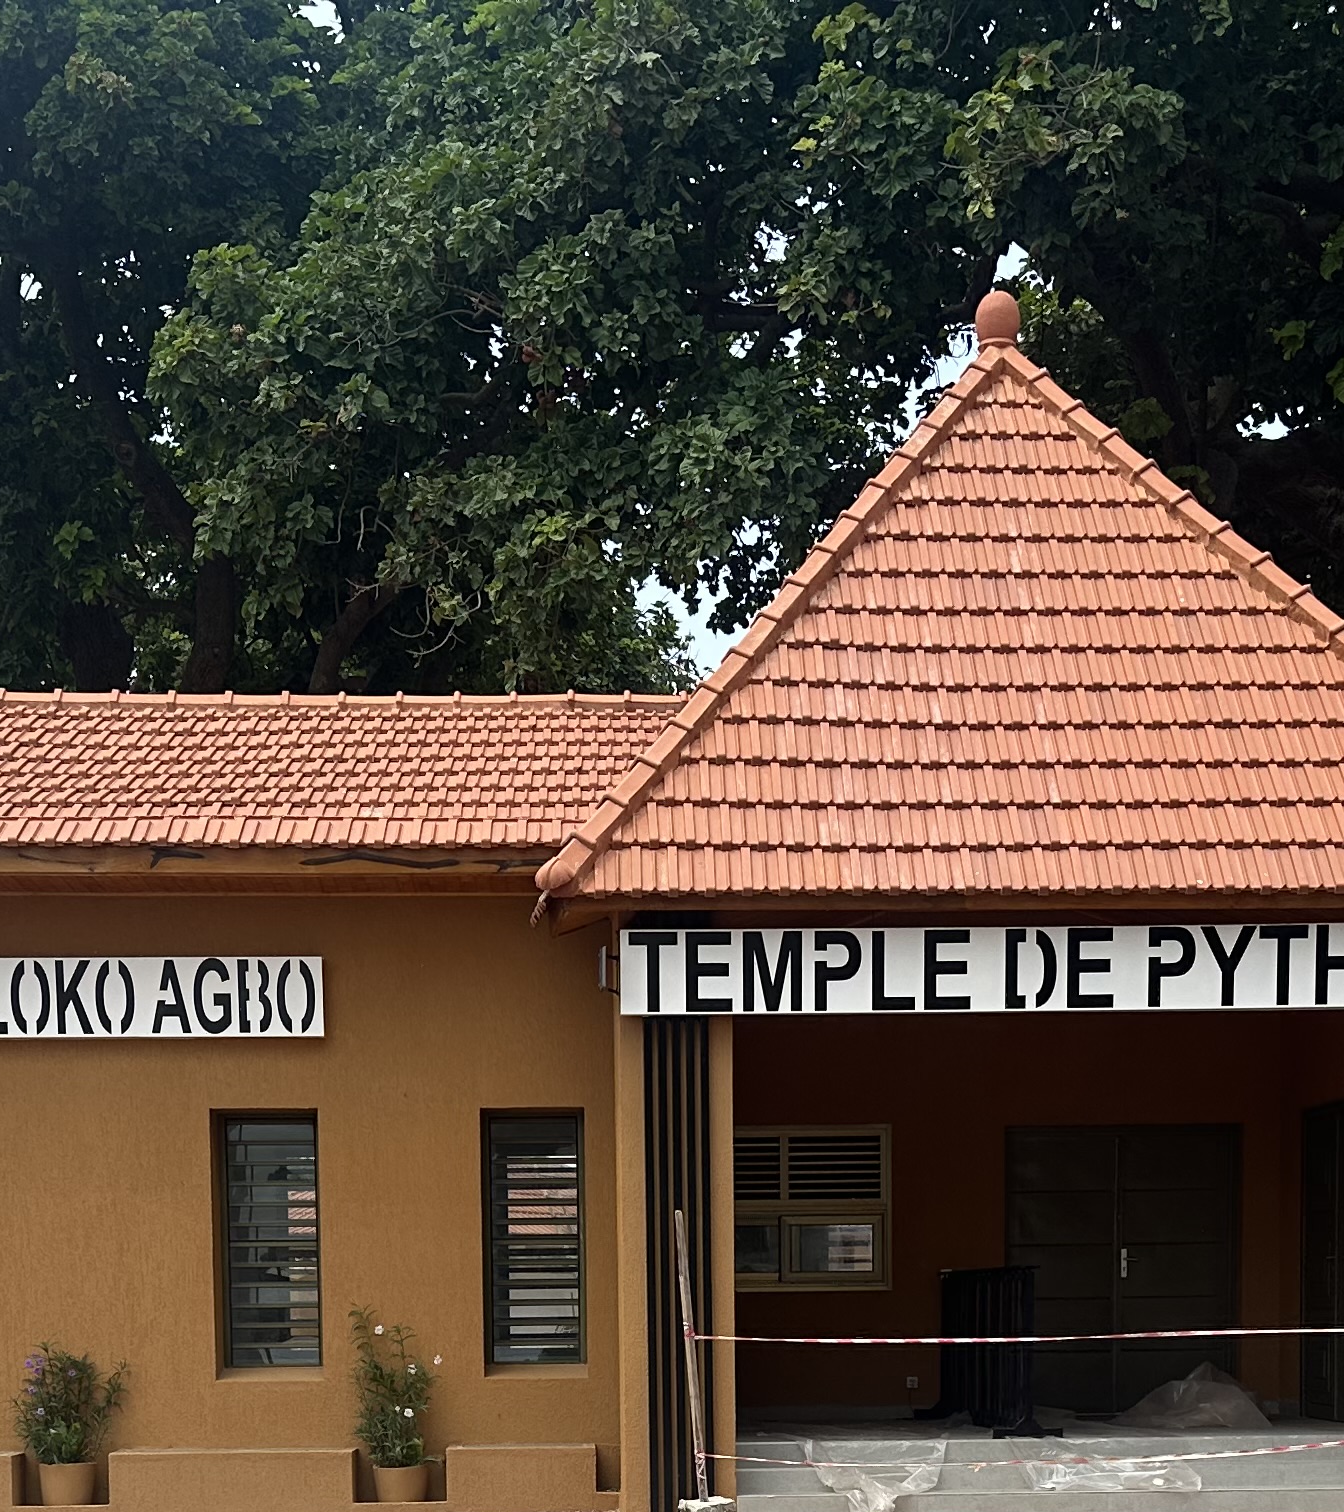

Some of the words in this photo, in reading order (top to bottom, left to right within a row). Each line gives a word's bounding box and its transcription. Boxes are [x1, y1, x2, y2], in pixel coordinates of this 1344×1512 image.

[152, 957, 316, 1035] AGBO
[628, 929, 971, 1013] TEMPLE
[1005, 926, 1114, 1009] DE
